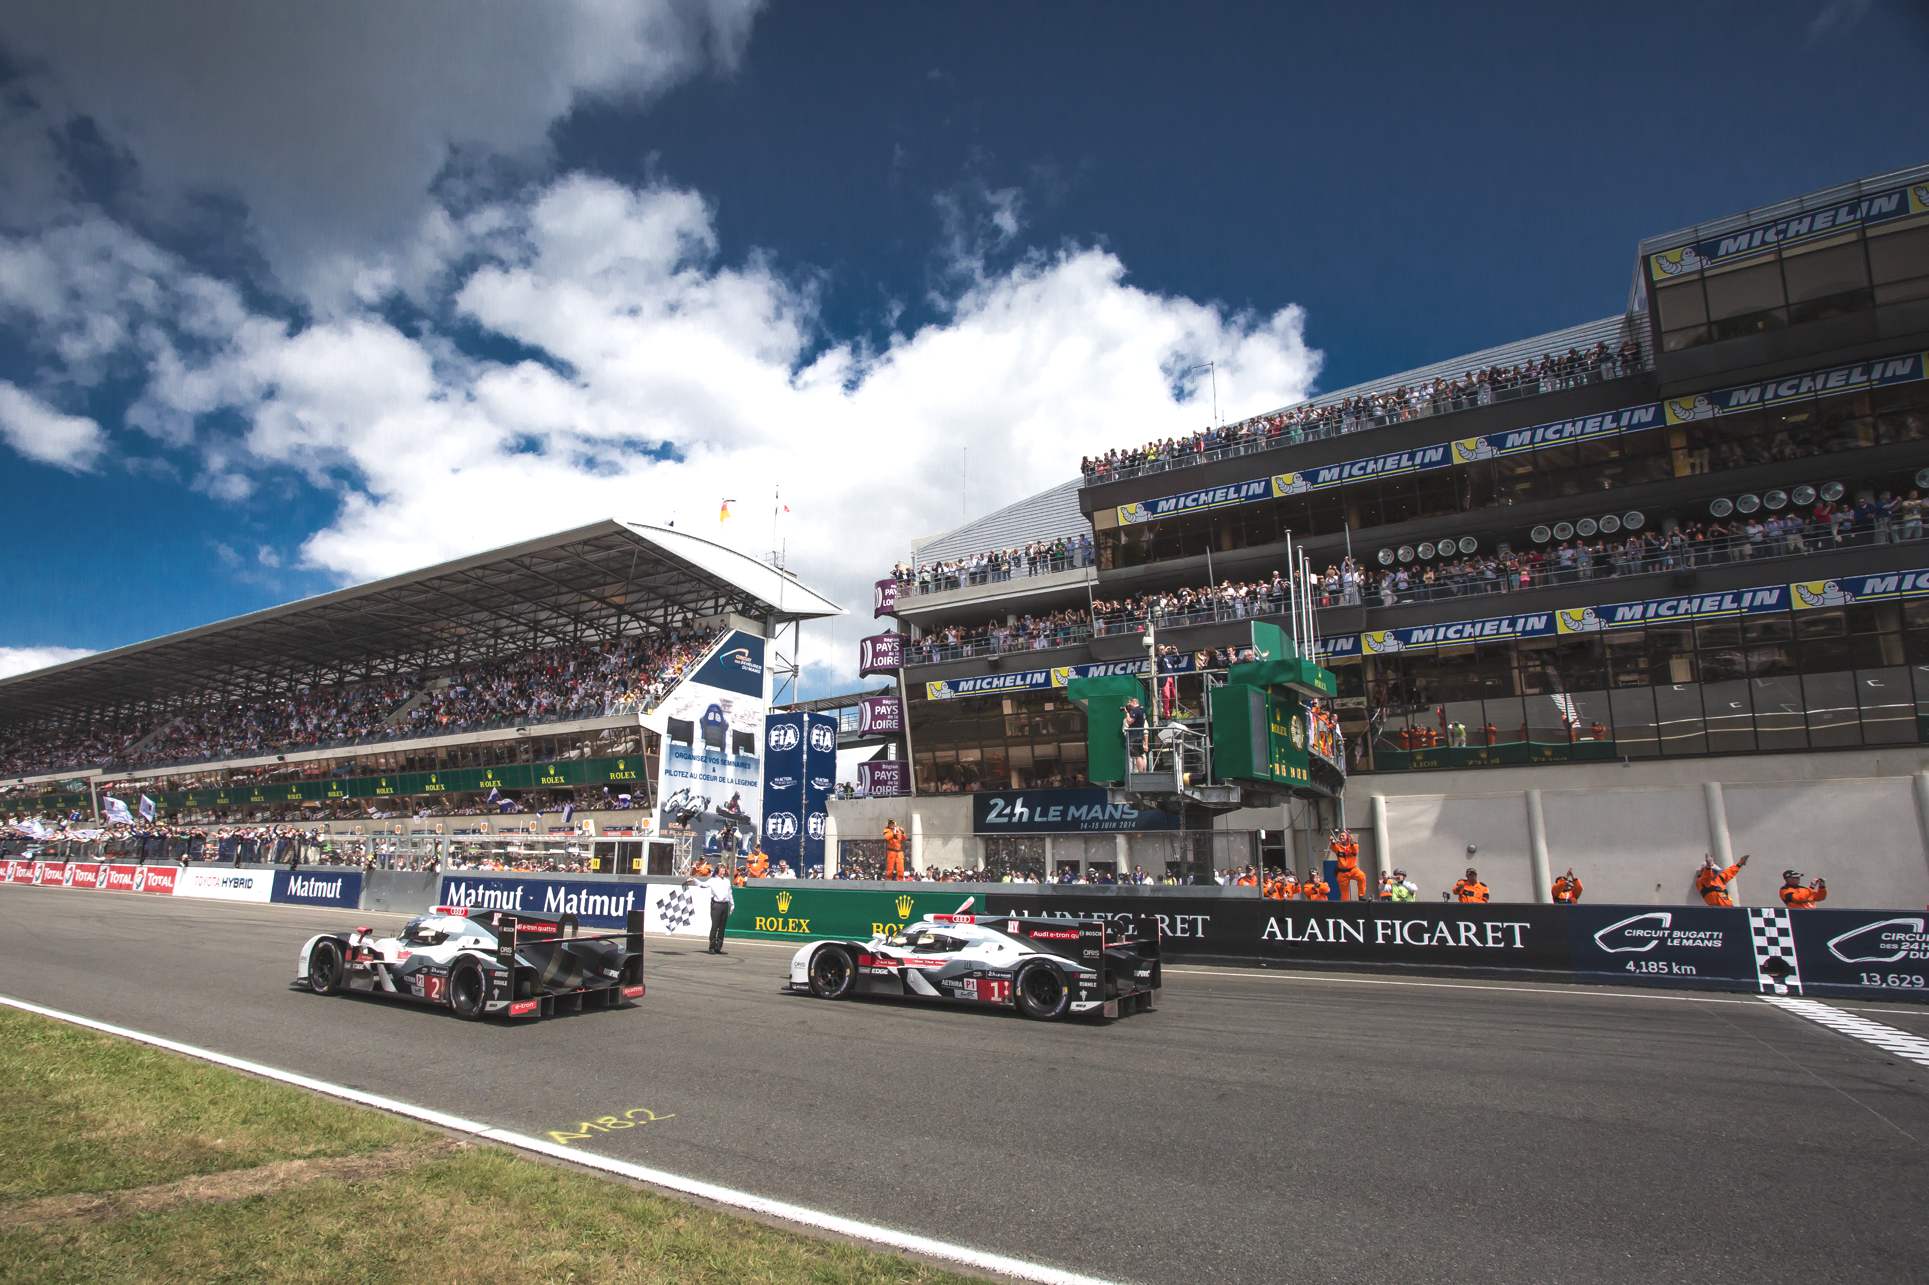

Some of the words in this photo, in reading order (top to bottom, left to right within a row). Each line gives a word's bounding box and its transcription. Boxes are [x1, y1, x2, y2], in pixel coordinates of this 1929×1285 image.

[1717, 194, 1900, 257] MICHELIN
[1728, 357, 1914, 408] MICHELIN
[1505, 405, 1657, 449] MICHELIN
[1317, 447, 1445, 484] MICHELIN
[1156, 481, 1266, 513] MICHELIN
[1614, 587, 1781, 622] MICHELIN
[1410, 615, 1548, 644] MICHELIN
[876, 642, 900, 653] PAYS
[873, 656, 900, 667] LOIRE
[958, 671, 1046, 692] MICHELIN
[875, 705, 898, 715] PAYS
[872, 719, 898, 730] LOIRE
[675, 752, 708, 764] ORGANISEZ
[541, 776, 564, 784] ROLEX
[610, 771, 636, 780] ROLEX
[665, 769, 688, 778] PILOTEZ
[699, 773, 717, 782] COEUR
[735, 778, 758, 787] LEGENDE
[874, 770, 898, 780] PAYS
[480, 780, 501, 788] ROLEX
[871, 786, 898, 795] LOIRE
[1034, 806, 1064, 822] LE
[1066, 804, 1139, 821] MANS
[1101, 821, 1116, 829] JUIN
[1119, 821, 1136, 829] 2014
[16, 866, 33, 877] TOTAL
[44, 868, 64, 880] TOTAL
[75, 870, 96, 882] TOTAL
[109, 871, 133, 884] TOTAL
[147, 873, 173, 887] TOTAL
[221, 877, 253, 889] HYBRID
[288, 876, 342, 898] Matmut
[446, 882, 524, 911] Matmut
[543, 885, 636, 917] Matmut
[755, 917, 811, 933] ROLEX
[1261, 916, 1365, 943] ALAIN
[1374, 919, 1531, 948] FIGARET
[1624, 929, 1670, 938] CIRCUIT
[1672, 930, 1723, 940] BUGATTI
[1667, 938, 1680, 946] LE
[1682, 939, 1722, 947] MANS
[1901, 942, 1920, 950] 24
[1625, 960, 1669, 974] 4,185
[1672, 962, 1696, 974] km
[966, 980, 975, 988] P1
[1860, 973, 1924, 987] 13,629
[431, 978, 440, 998] 2
[990, 982, 1001, 1001] 1
[515, 1002, 534, 1010] e-tron
